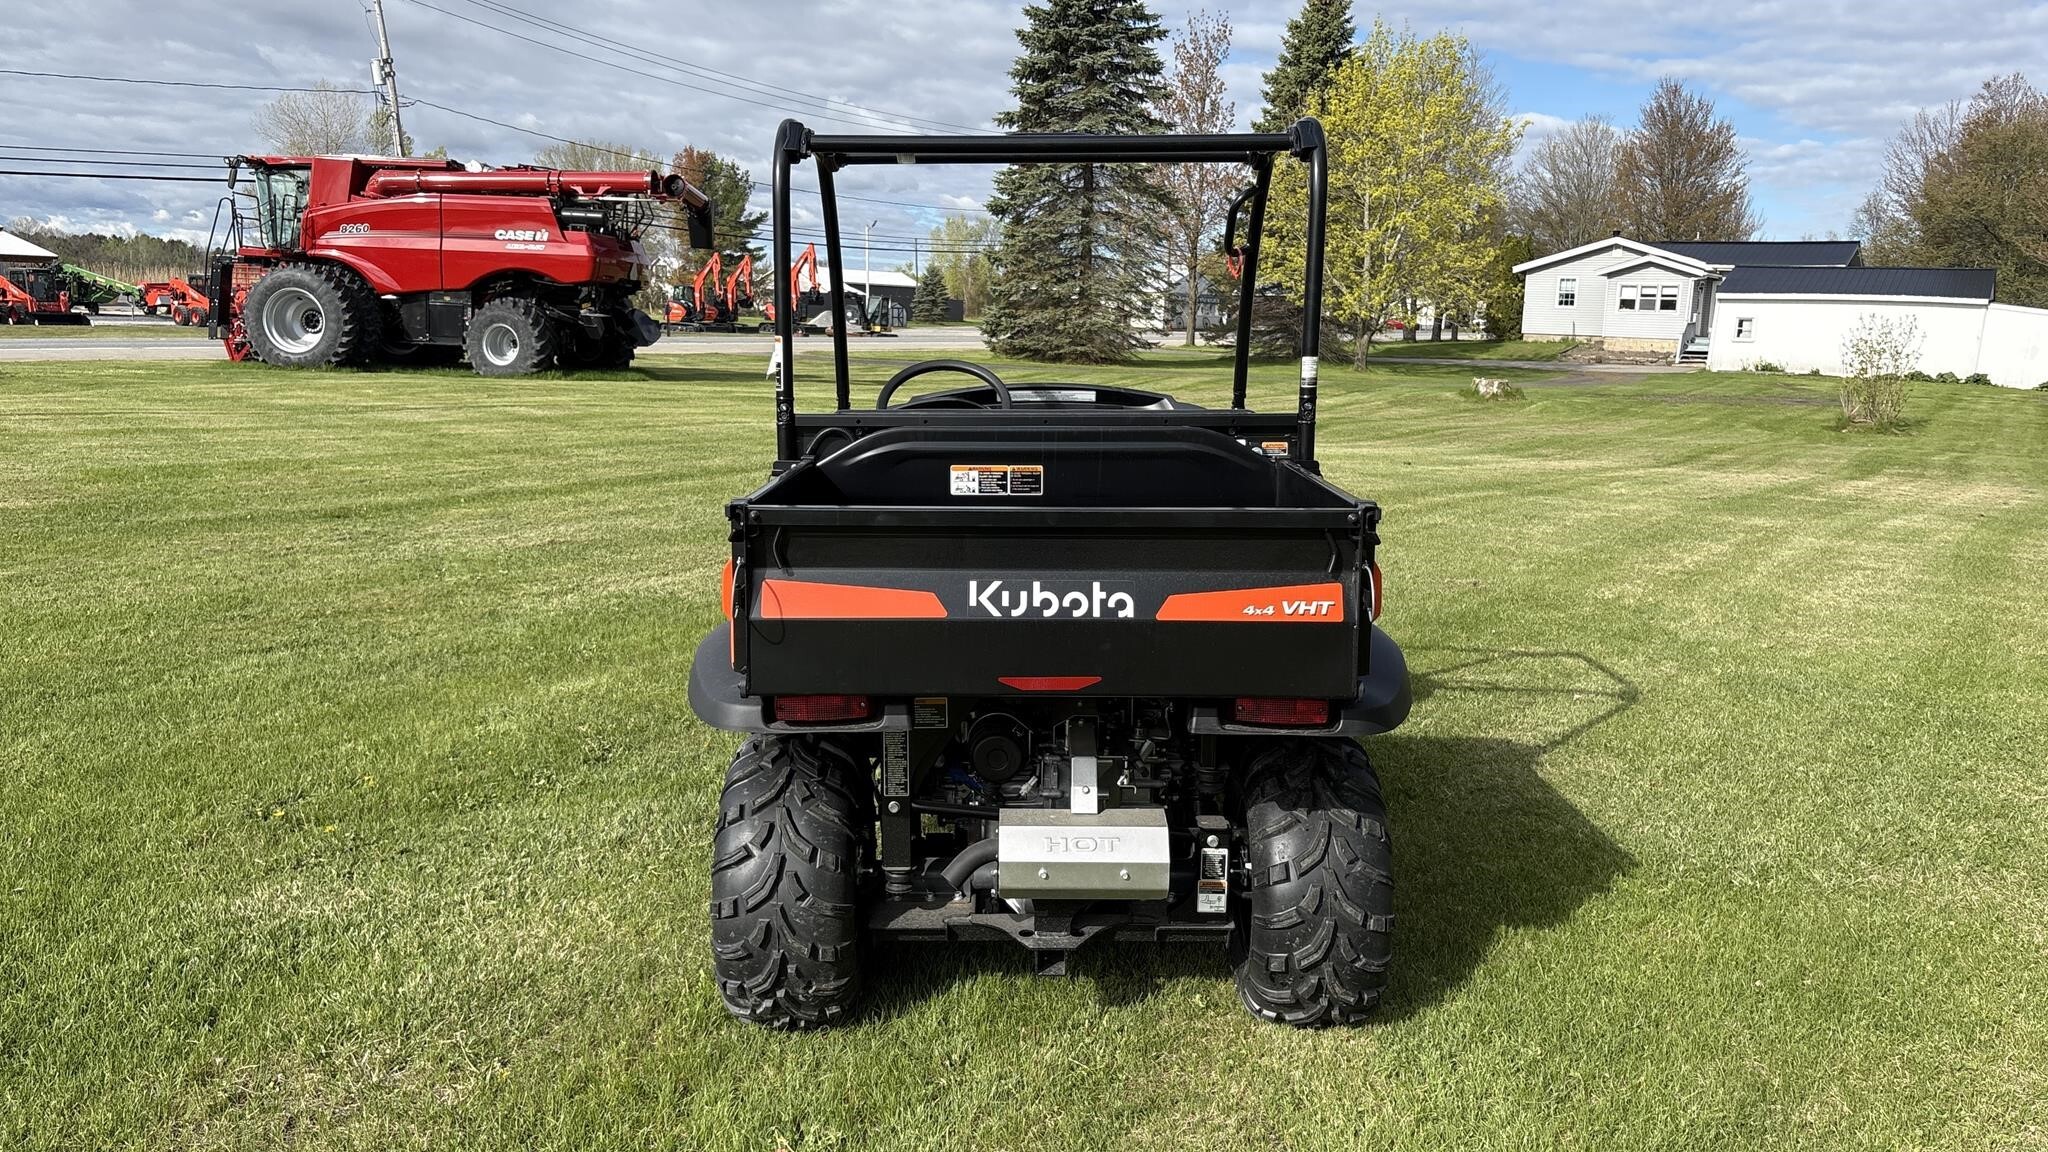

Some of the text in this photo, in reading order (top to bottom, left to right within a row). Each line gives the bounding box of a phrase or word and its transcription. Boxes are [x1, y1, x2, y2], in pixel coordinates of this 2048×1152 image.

[340, 223, 370, 234] 8260
[494, 229, 535, 241] CASE
[969, 580, 1135, 618] Kubota
[1242, 600, 1335, 616] 4x4 VHT
[1043, 836, 1121, 852] HOT
